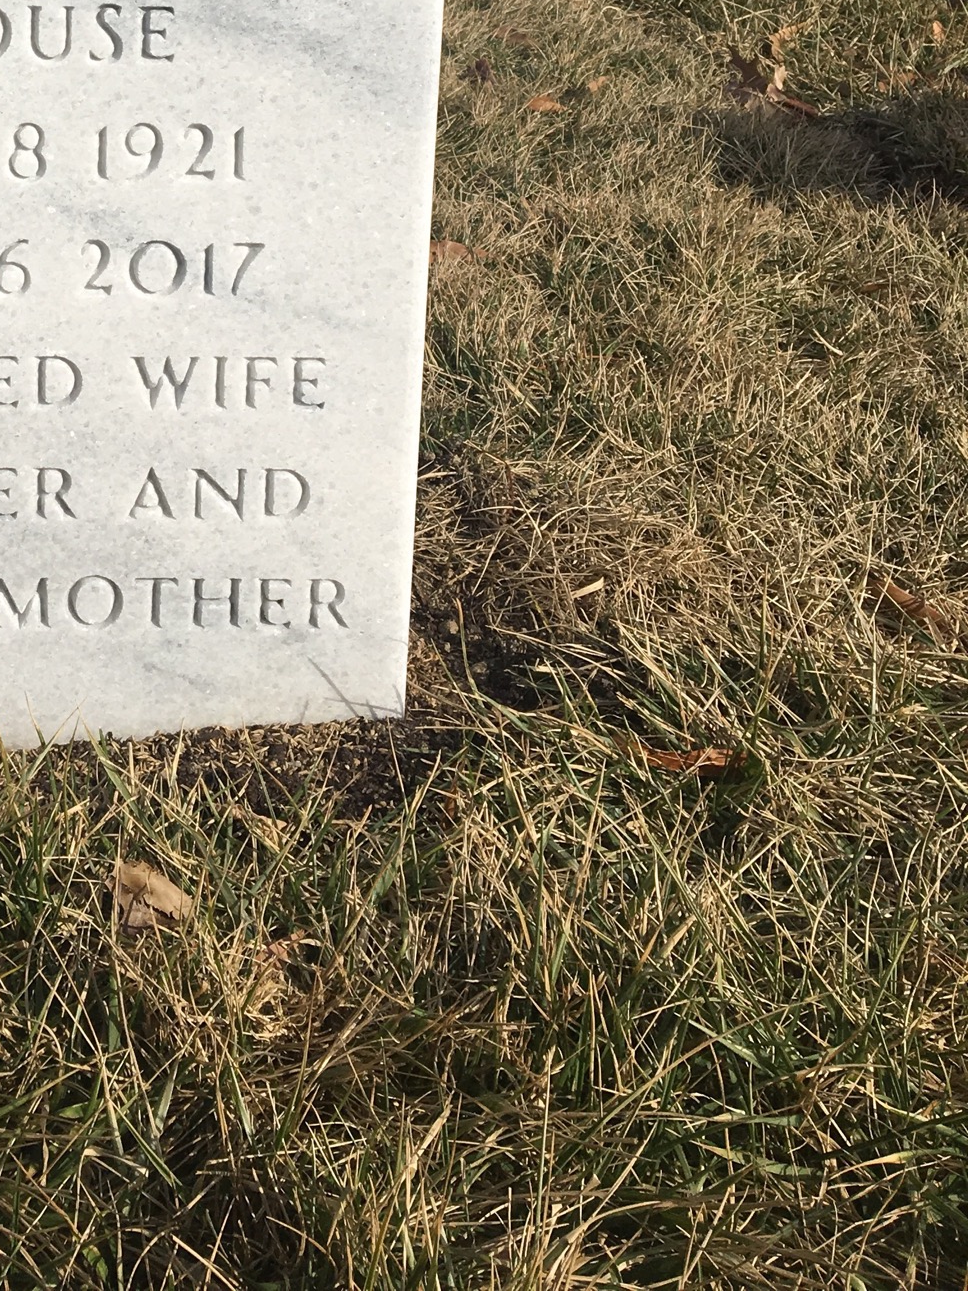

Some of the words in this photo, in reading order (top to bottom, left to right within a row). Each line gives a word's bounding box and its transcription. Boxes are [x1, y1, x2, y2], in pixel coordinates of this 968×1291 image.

[8, 122, 47, 181] 8
[96, 122, 245, 182] 1921
[80, 239, 266, 297] 2017
[130, 355, 328, 410] WIFE
[128, 466, 312, 521] AND
